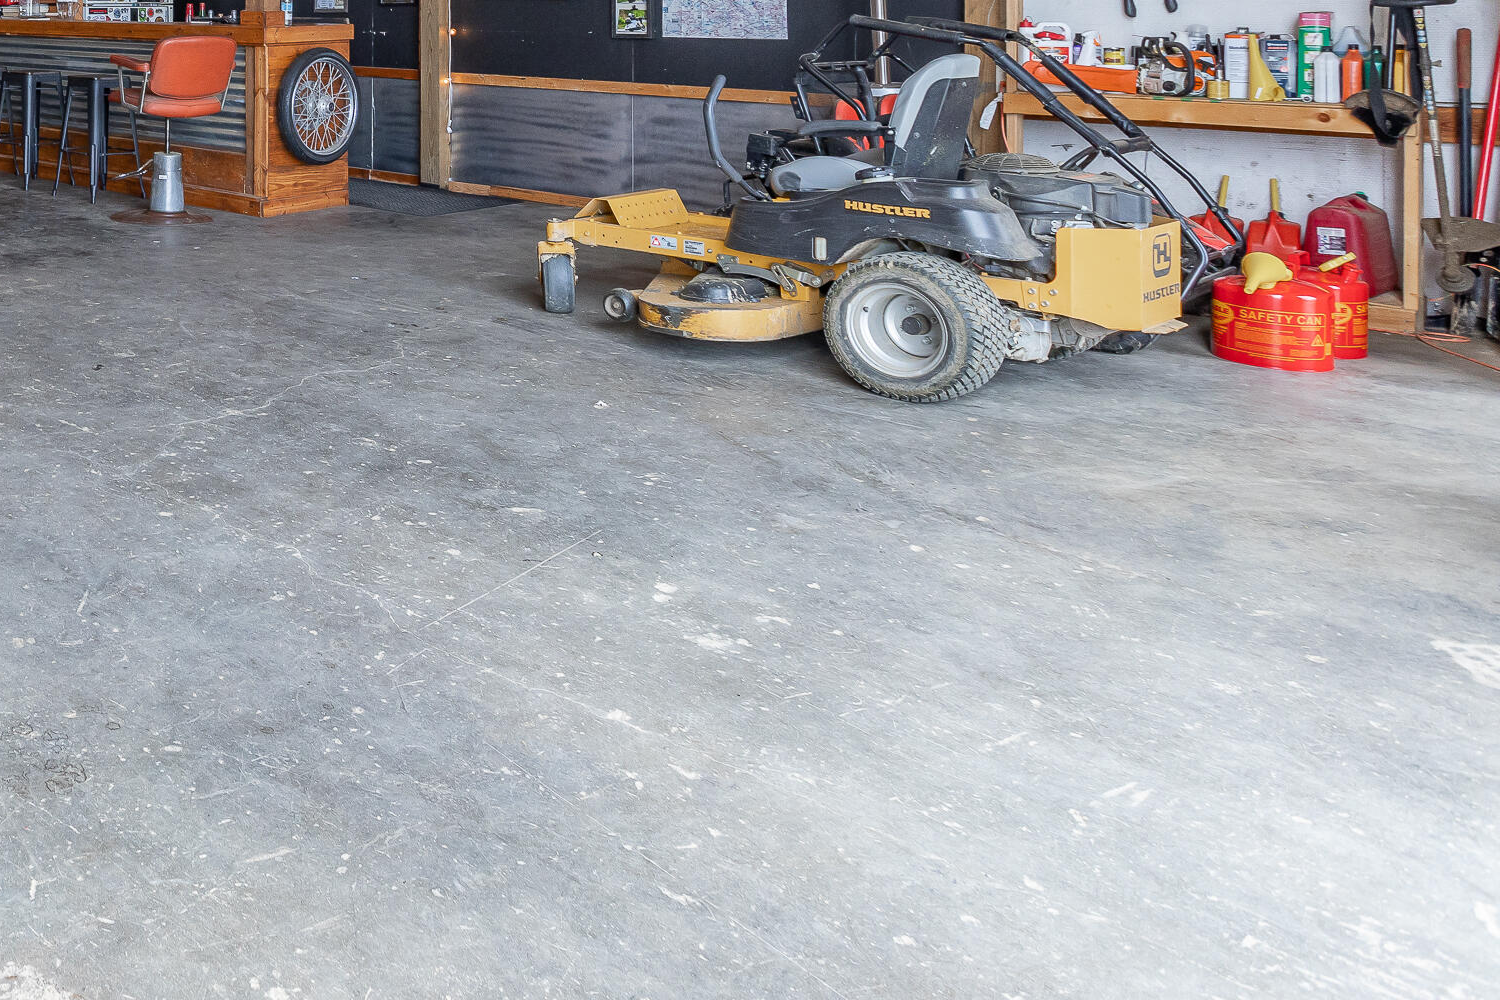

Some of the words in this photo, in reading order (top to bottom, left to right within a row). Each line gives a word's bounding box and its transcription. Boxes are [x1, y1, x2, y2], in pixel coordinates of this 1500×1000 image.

[844, 200, 931, 219] HUSTLER
[1142, 282, 1181, 304] HUSTLER
[1240, 309, 1293, 325] SAFETY
[1297, 315, 1322, 326] CAN
